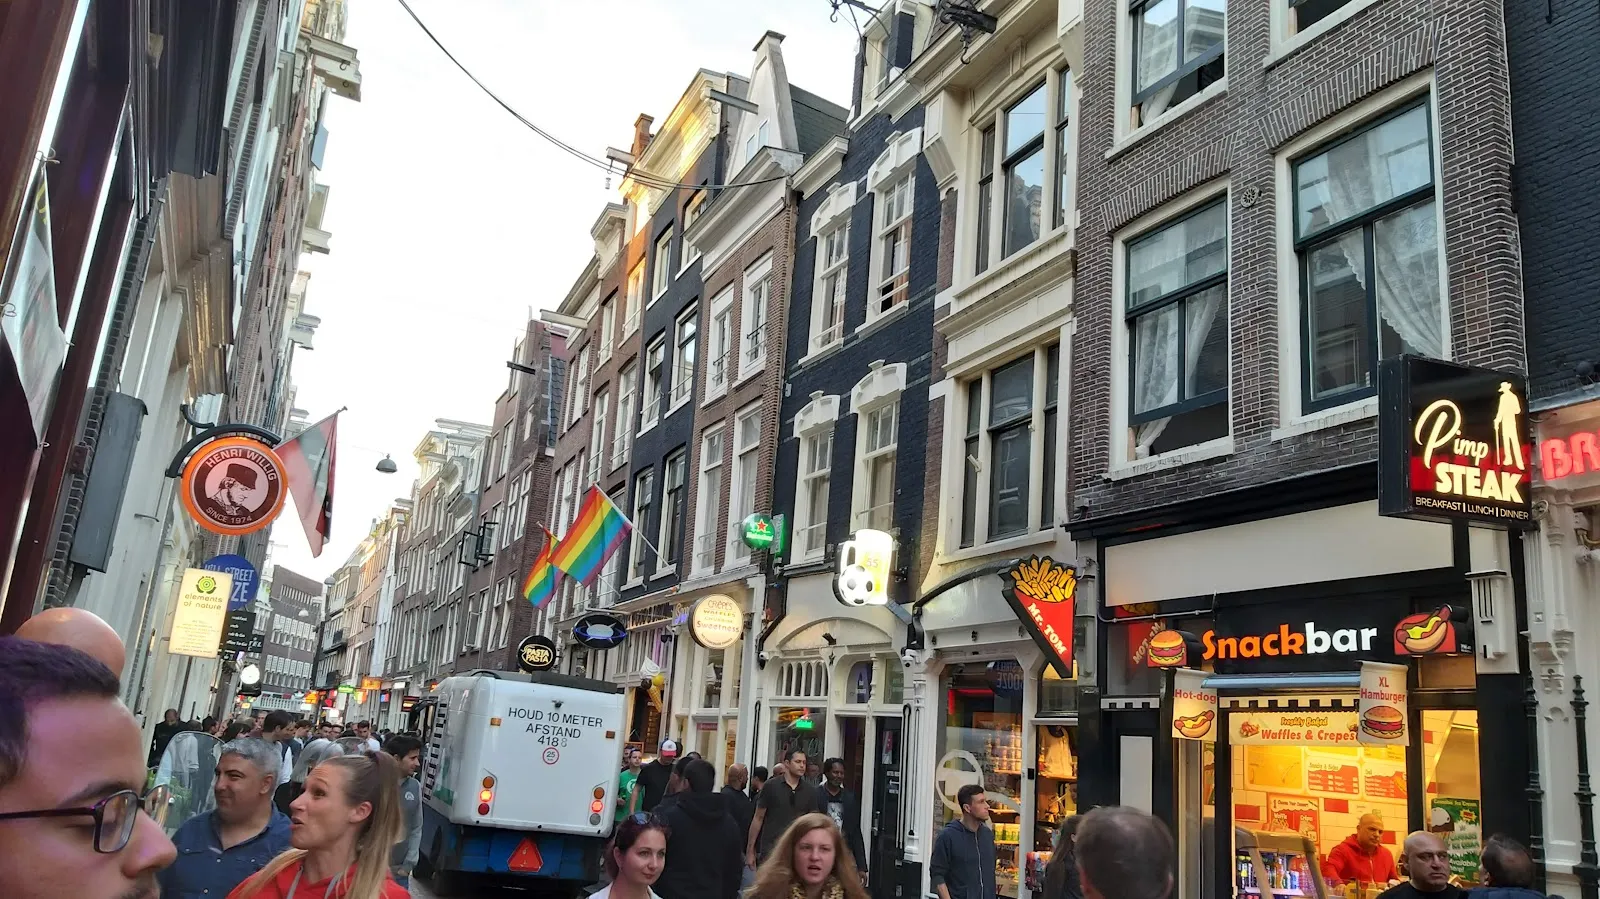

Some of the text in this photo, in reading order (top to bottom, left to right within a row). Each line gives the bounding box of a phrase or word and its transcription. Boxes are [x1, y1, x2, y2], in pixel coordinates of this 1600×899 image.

[1414, 399, 1489, 470] Pimp
[1541, 428, 1600, 481] BR
[205, 448, 277, 481] HENRI WILLIG
[1435, 461, 1523, 504] STEAK
[206, 506, 253, 524] SINCE 1974
[1415, 496, 1529, 520] BREAKFAST LUNCH DINNER
[184, 592, 223, 603] elements
[195, 601, 222, 611] nature
[696, 620, 740, 633] Sweetness
[1044, 624, 1067, 655] TOM
[1202, 621, 1378, 661] Snackbar
[525, 654, 549, 663] PASTA
[526, 647, 550, 657] PASTA
[1378, 676, 1389, 688] XL
[1174, 688, 1217, 704] Hot-dog
[1360, 687, 1406, 704] Hamburger
[508, 707, 603, 727] HOUD 10 METER
[525, 722, 581, 739] AFSTAND
[1261, 728, 1356, 743] Waffles & Crepes
